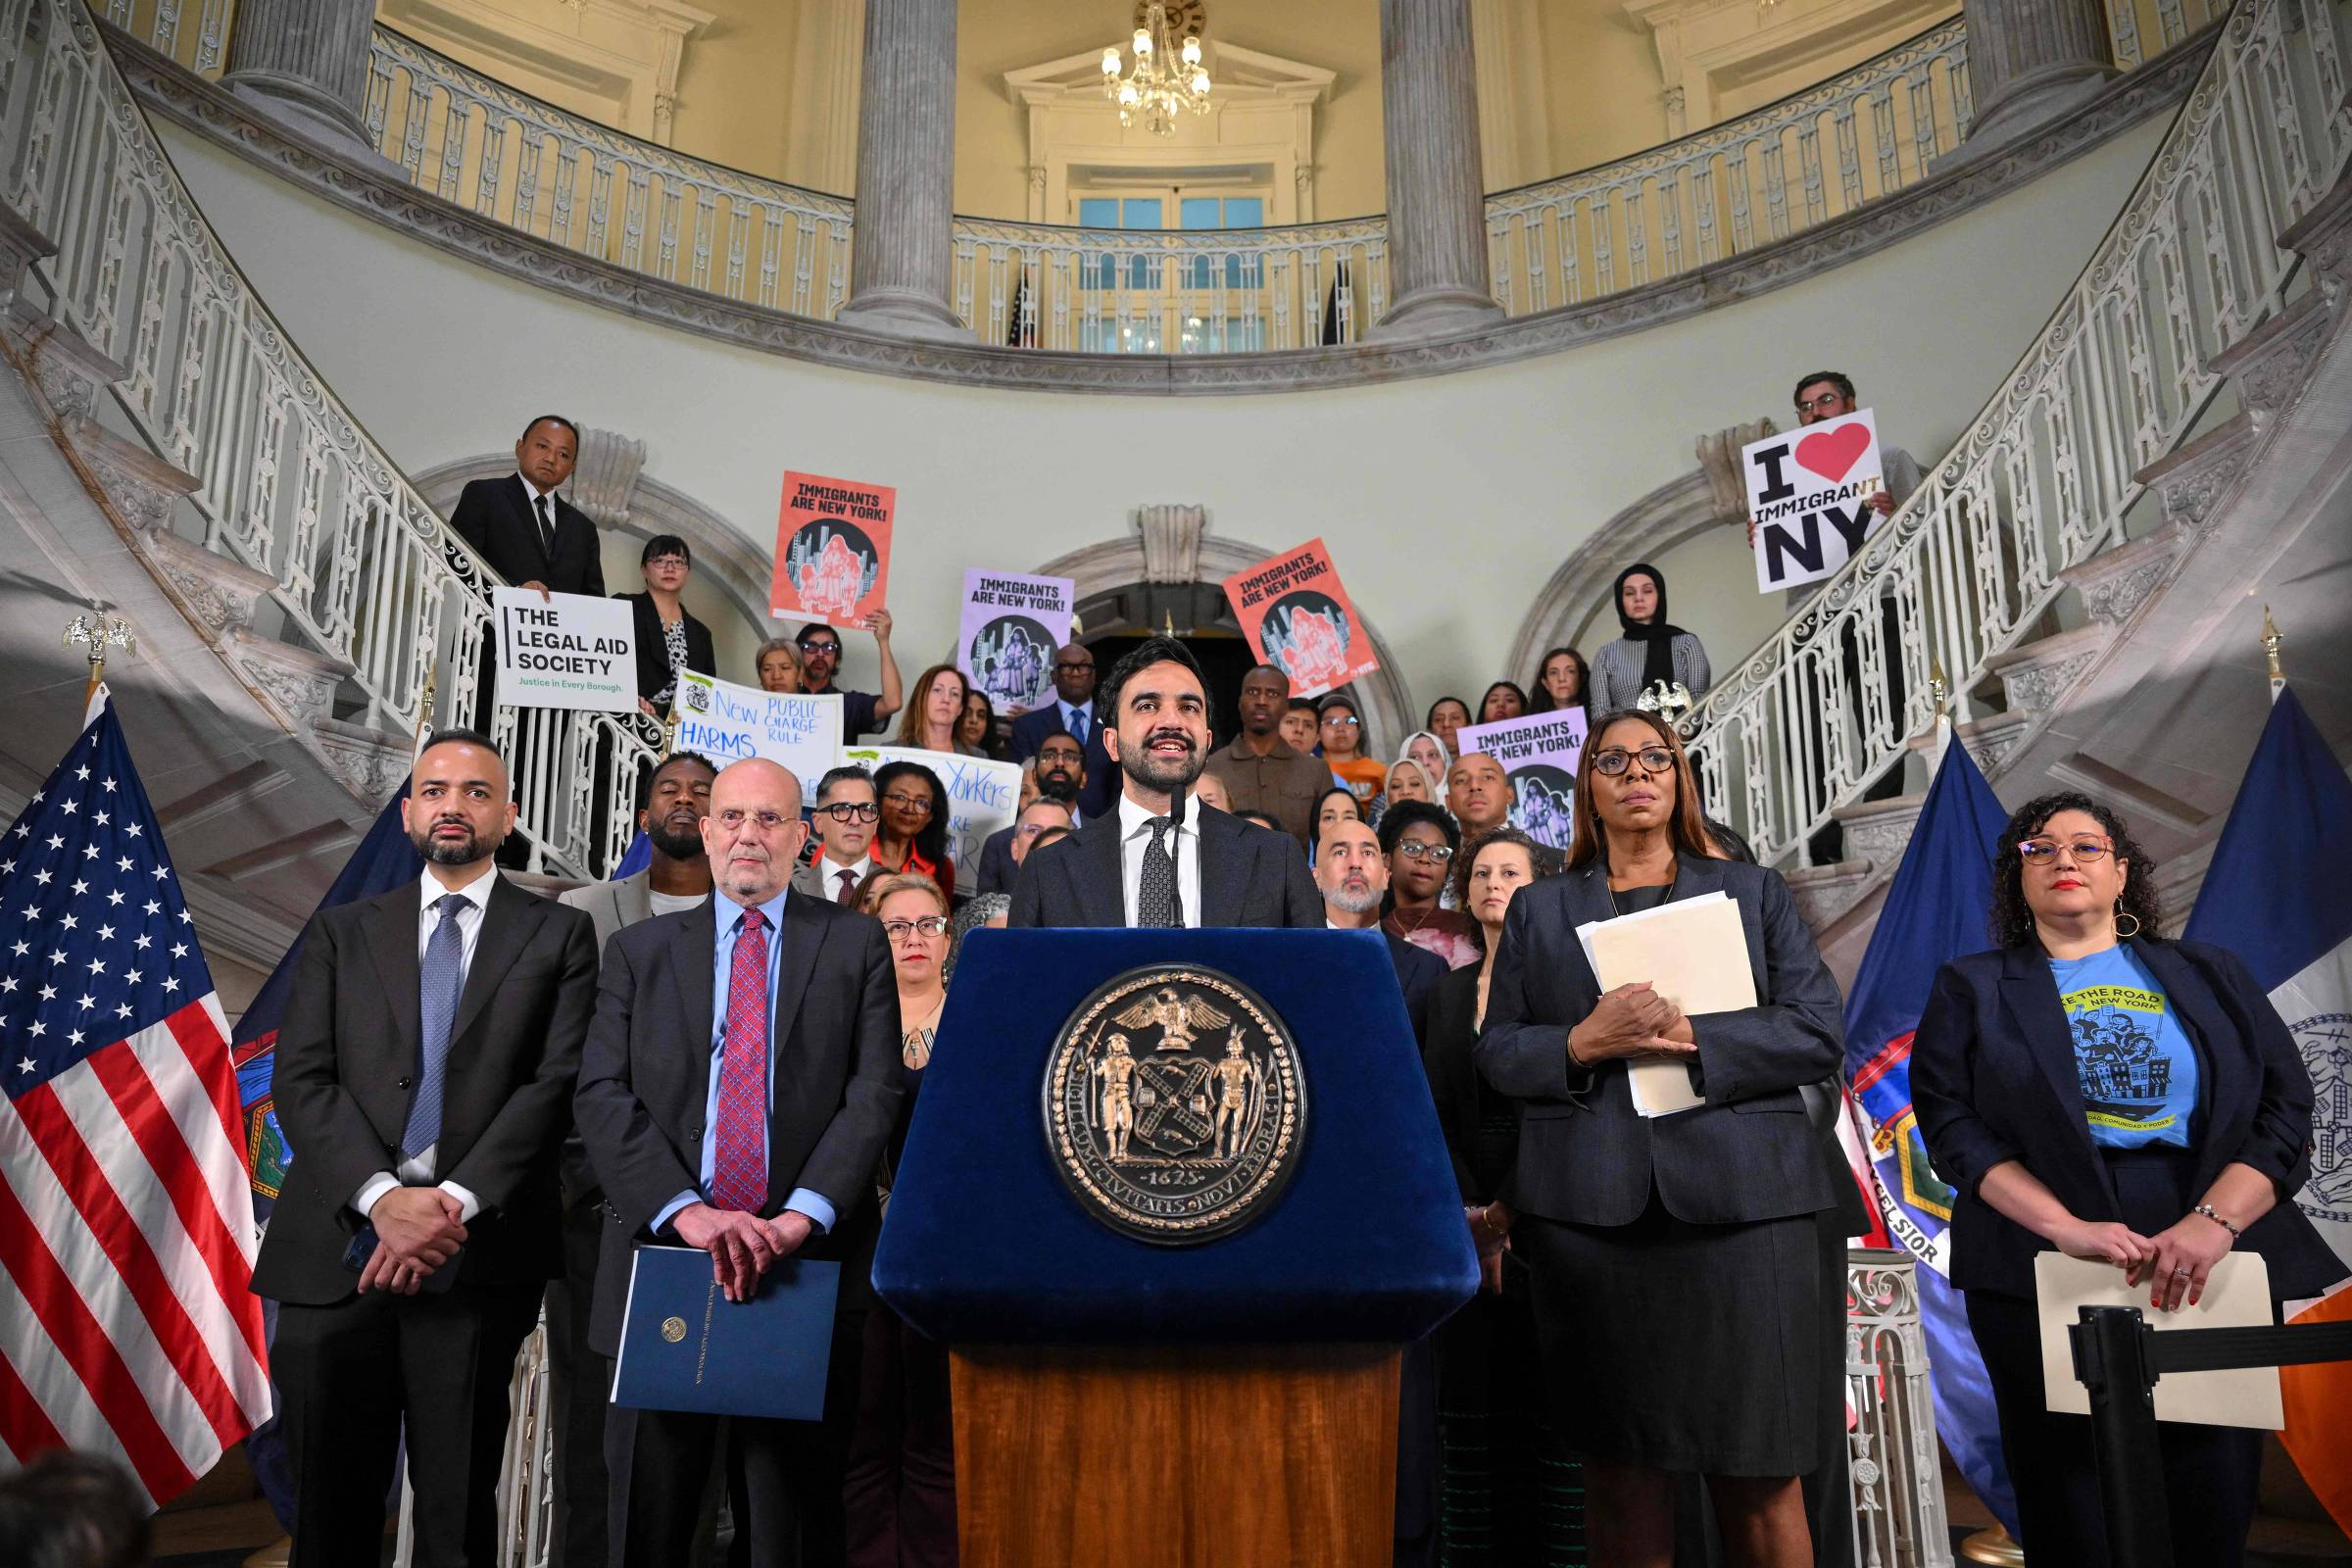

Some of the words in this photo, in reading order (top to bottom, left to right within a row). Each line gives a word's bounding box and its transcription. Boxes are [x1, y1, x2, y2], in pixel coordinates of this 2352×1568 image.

[1753, 443, 1794, 506] I
[798, 483, 879, 507] IMMIGRANTS
[1755, 476, 1881, 524] IMMIGRANT
[791, 496, 814, 511] ARE
[817, 501, 847, 515] NEW
[850, 506, 887, 521] YORK!
[1763, 501, 1873, 583] NY
[1239, 553, 1314, 594] IMMIGRANTS
[1241, 592, 1263, 609] ARE
[1265, 578, 1291, 597] NEW
[1293, 561, 1328, 584] YORK!
[980, 578, 1058, 599] IMMIGRANTS
[971, 591, 995, 605] ARE
[998, 593, 1026, 608] NEW
[1029, 598, 1065, 612] YORK!
[514, 607, 559, 627] THE
[516, 630, 588, 652] LEGAL
[594, 638, 628, 655] AID
[517, 653, 612, 675] SOCIETY
[518, 677, 550, 687] Justice
[562, 680, 585, 691] Every
[587, 682, 623, 693] Borough.
[715, 690, 758, 725] New
[767, 697, 822, 718] PUBLIC
[764, 716, 818, 734] CHARGE
[767, 728, 803, 745] RULE
[1477, 721, 1569, 750] IMMIGRANTS
[681, 720, 757, 759] HARMS
[1501, 742, 1533, 760] NEW
[1537, 734, 1581, 754] YORK!
[946, 760, 1011, 810] Yorkers
[2077, 988, 2109, 1000] THE
[2113, 988, 2160, 1003] ROAD
[2090, 998, 2120, 1006] NEW
[2124, 999, 2157, 1009] YORK
[2104, 1117, 2141, 1129] COMUNIDAD
[2148, 1119, 2169, 1128] PODER
[1150, 1170, 1199, 1186] 1625
[1197, 1174, 1243, 1210] NOVI
